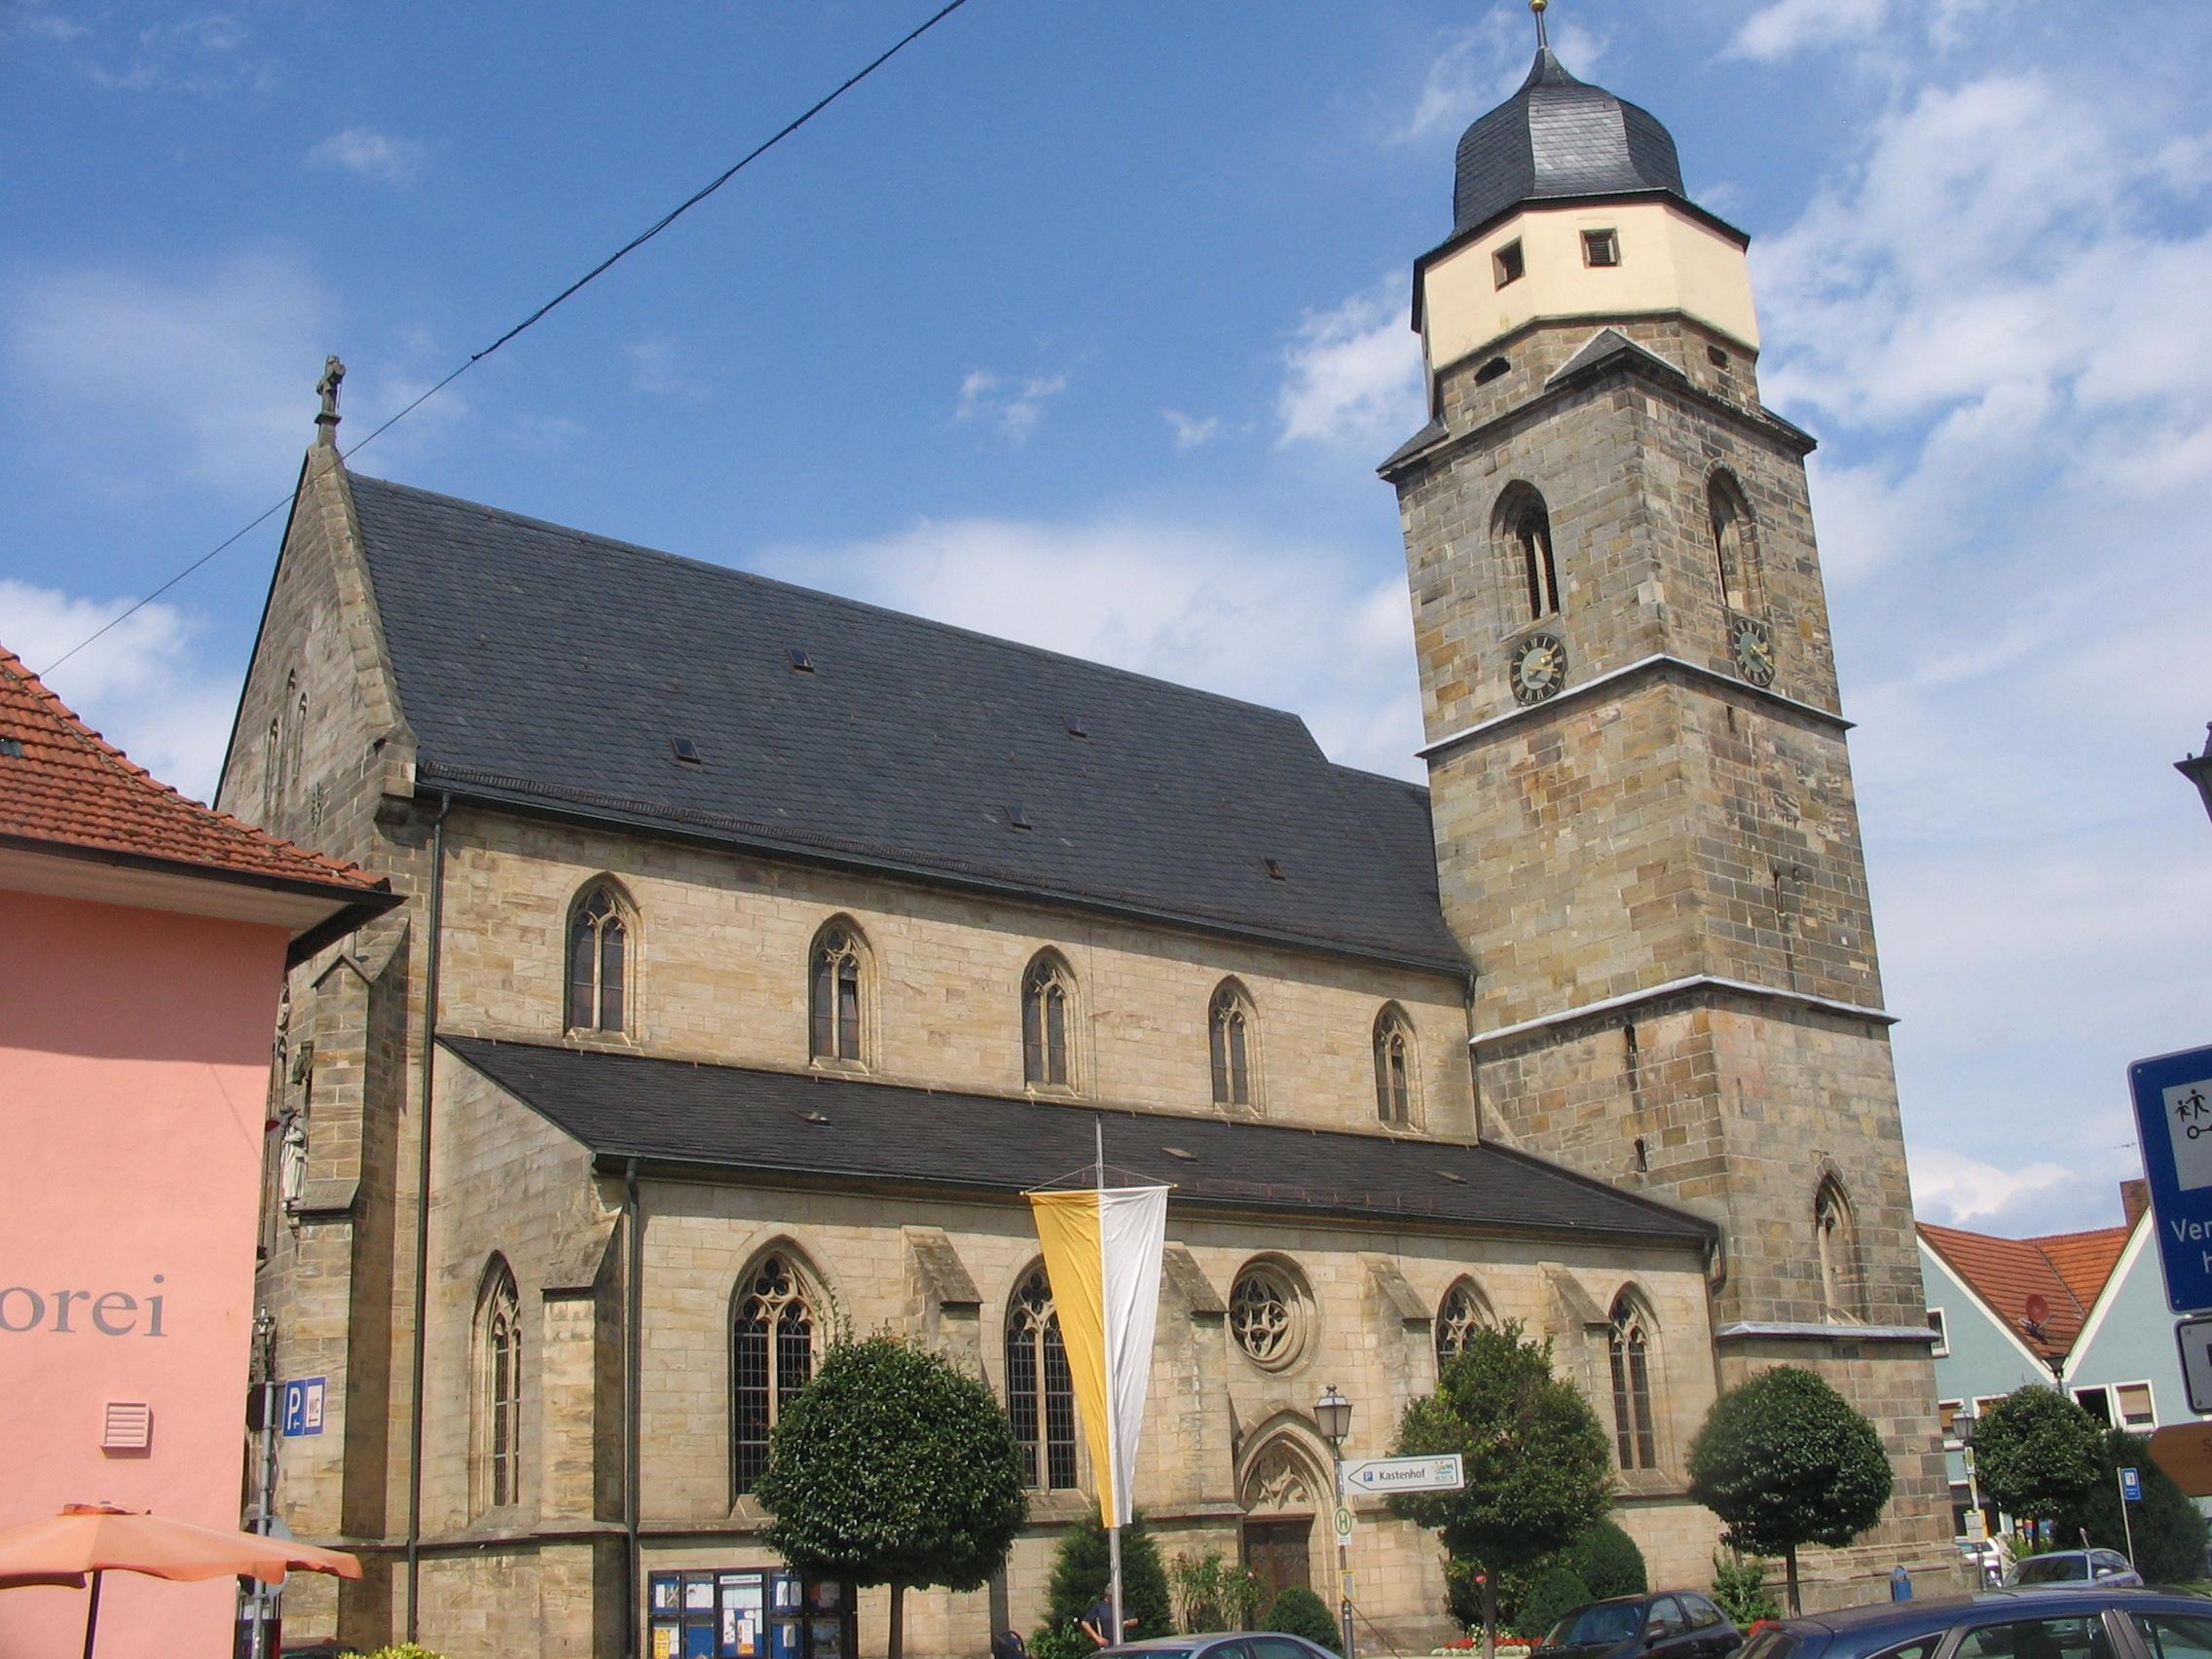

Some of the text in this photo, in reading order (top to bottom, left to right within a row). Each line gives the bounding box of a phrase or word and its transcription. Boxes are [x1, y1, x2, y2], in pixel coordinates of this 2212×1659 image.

[0, 1273, 167, 1337] orei
[287, 1386, 301, 1430] P
[308, 1398, 319, 1414] WC
[1379, 1467, 1425, 1480] Kastenhof
[1339, 1514, 1347, 1530] H
